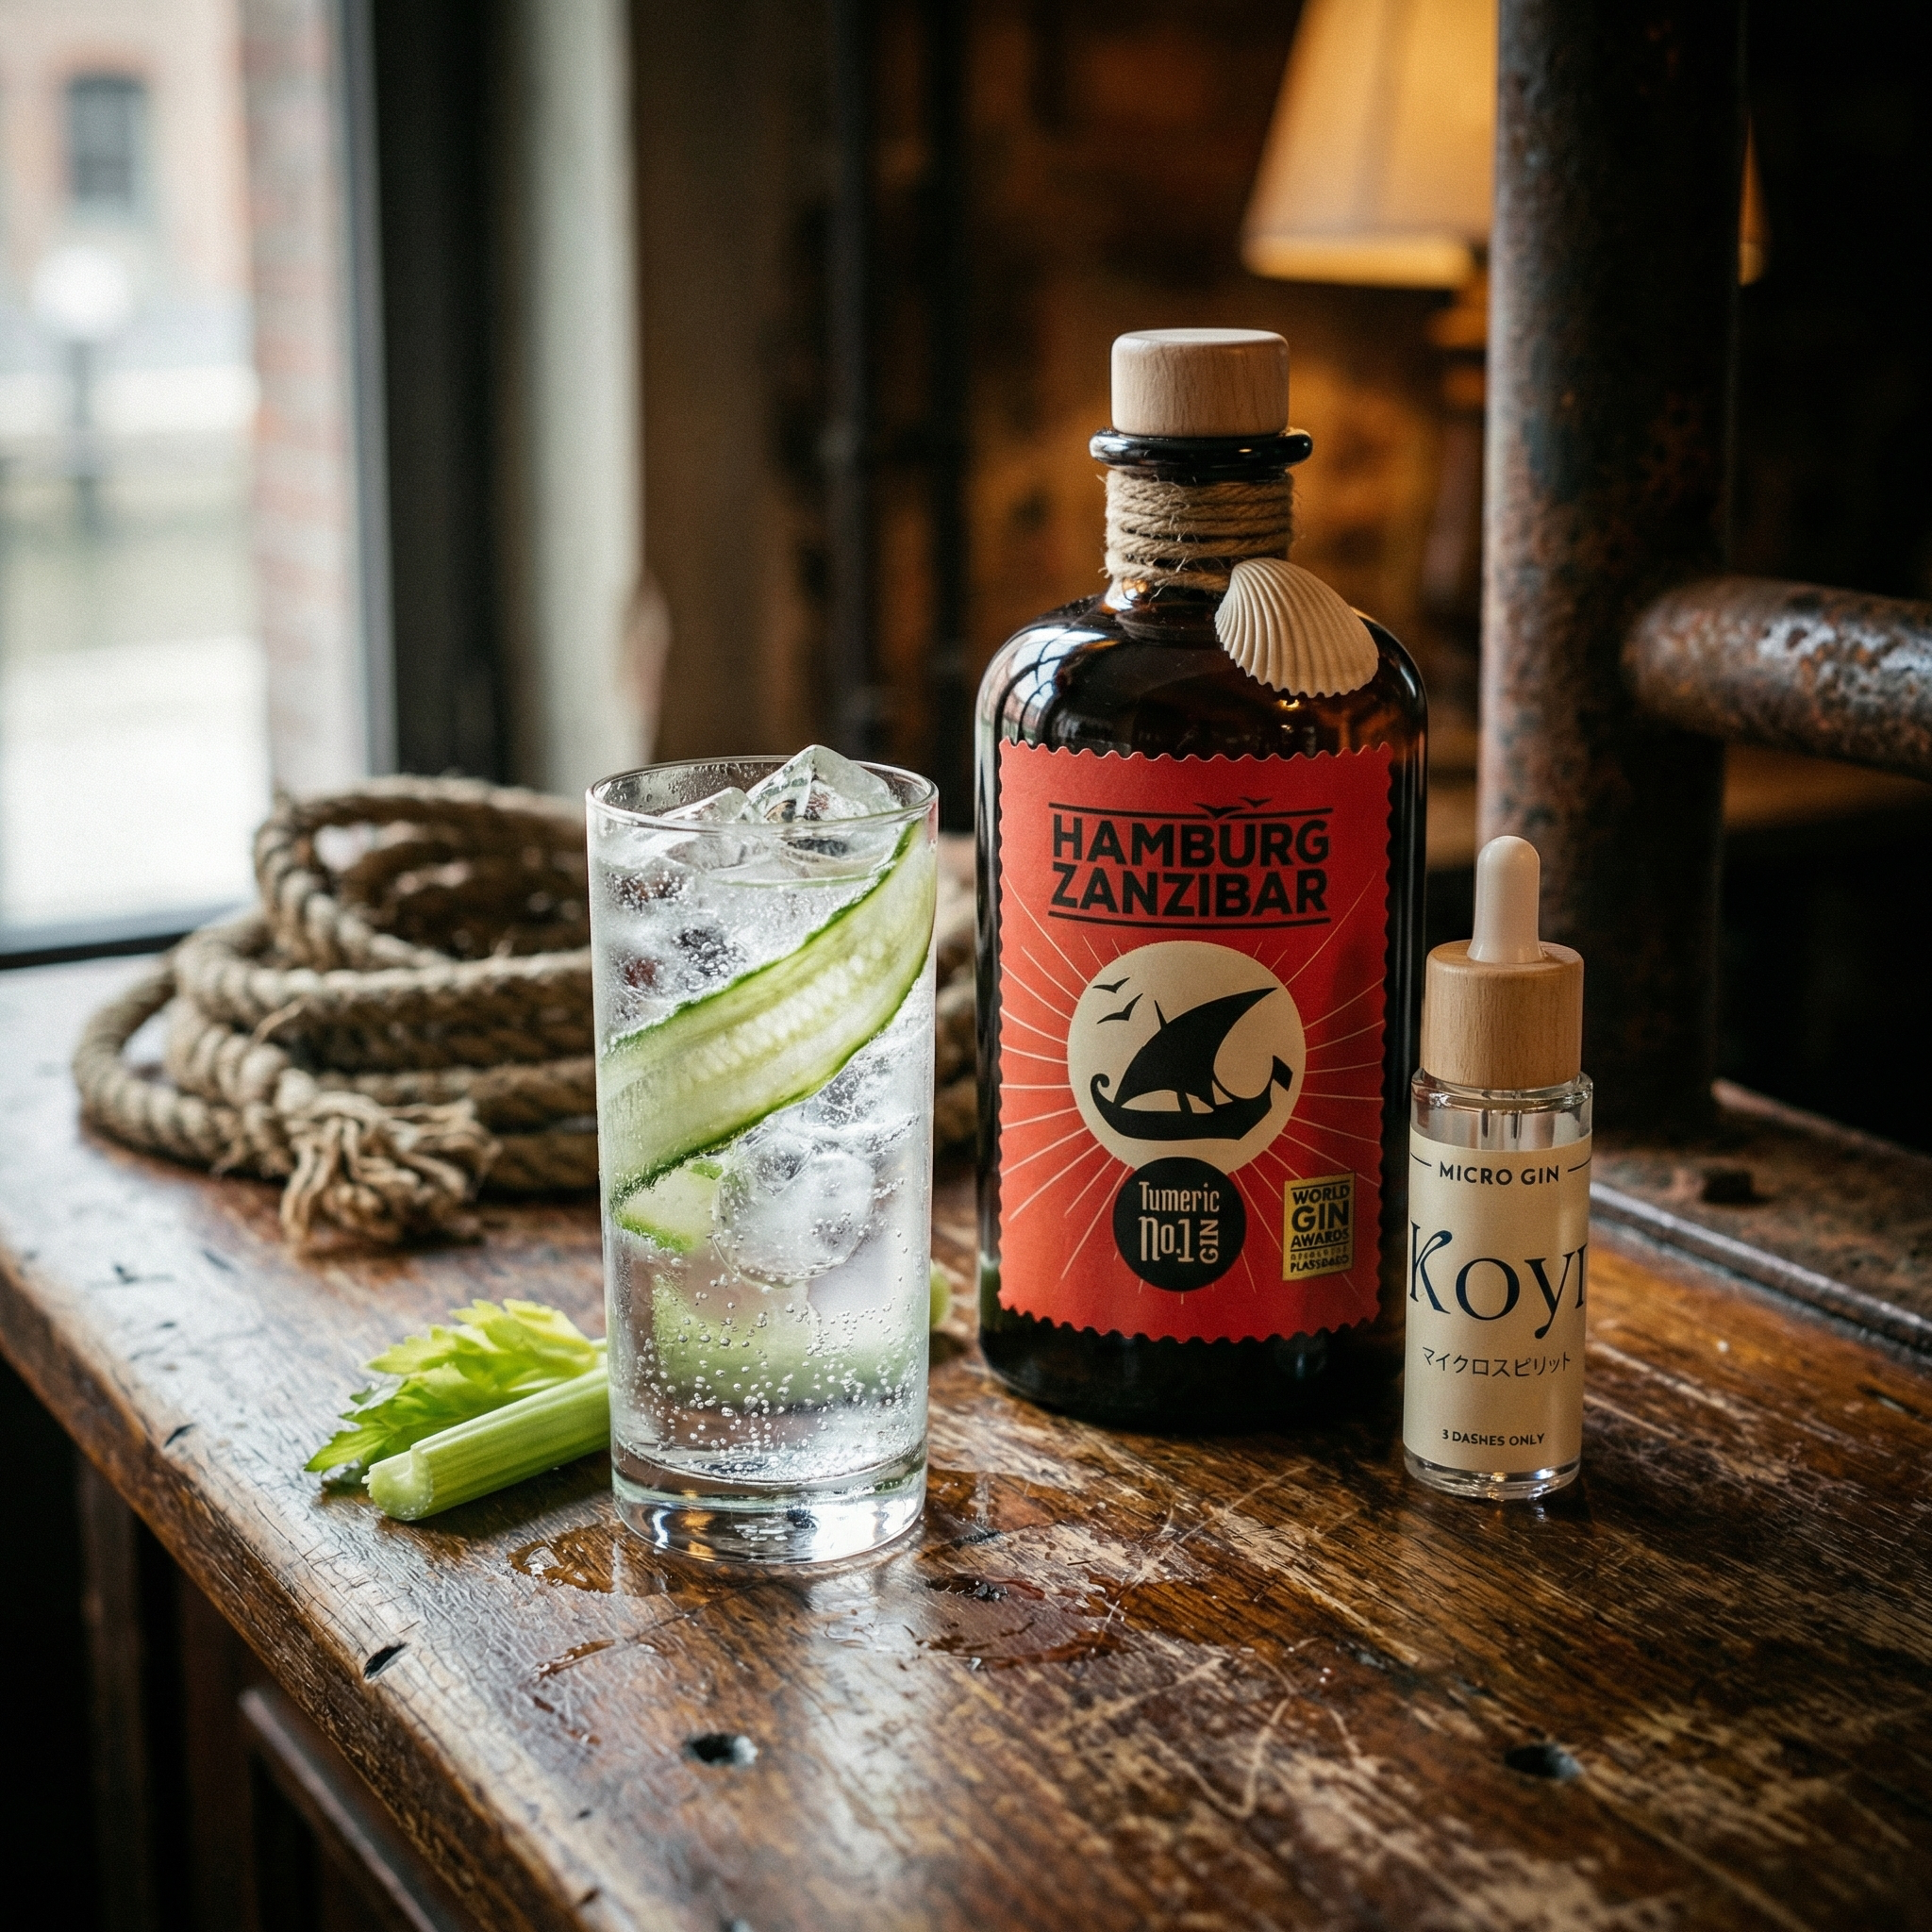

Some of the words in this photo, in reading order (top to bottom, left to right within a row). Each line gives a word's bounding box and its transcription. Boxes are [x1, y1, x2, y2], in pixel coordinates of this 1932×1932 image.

[1052, 813, 1330, 868] HAMBURG
[1050, 860, 1327, 918] ZANZIBAR
[1439, 1160, 1513, 1186] MICRO
[1520, 1164, 1559, 1186] GIN
[1138, 1181, 1221, 1213] Tumeric
[1292, 1184, 1350, 1206] WORLD
[1291, 1200, 1349, 1233] GIN
[1199, 1219, 1219, 1264] GIN
[1422, 1346, 1571, 1377] マイクロスピリット
[1441, 1429, 1449, 1440] 3
[1452, 1431, 1506, 1446] DASHES
[1508, 1433, 1545, 1446] ONLY
